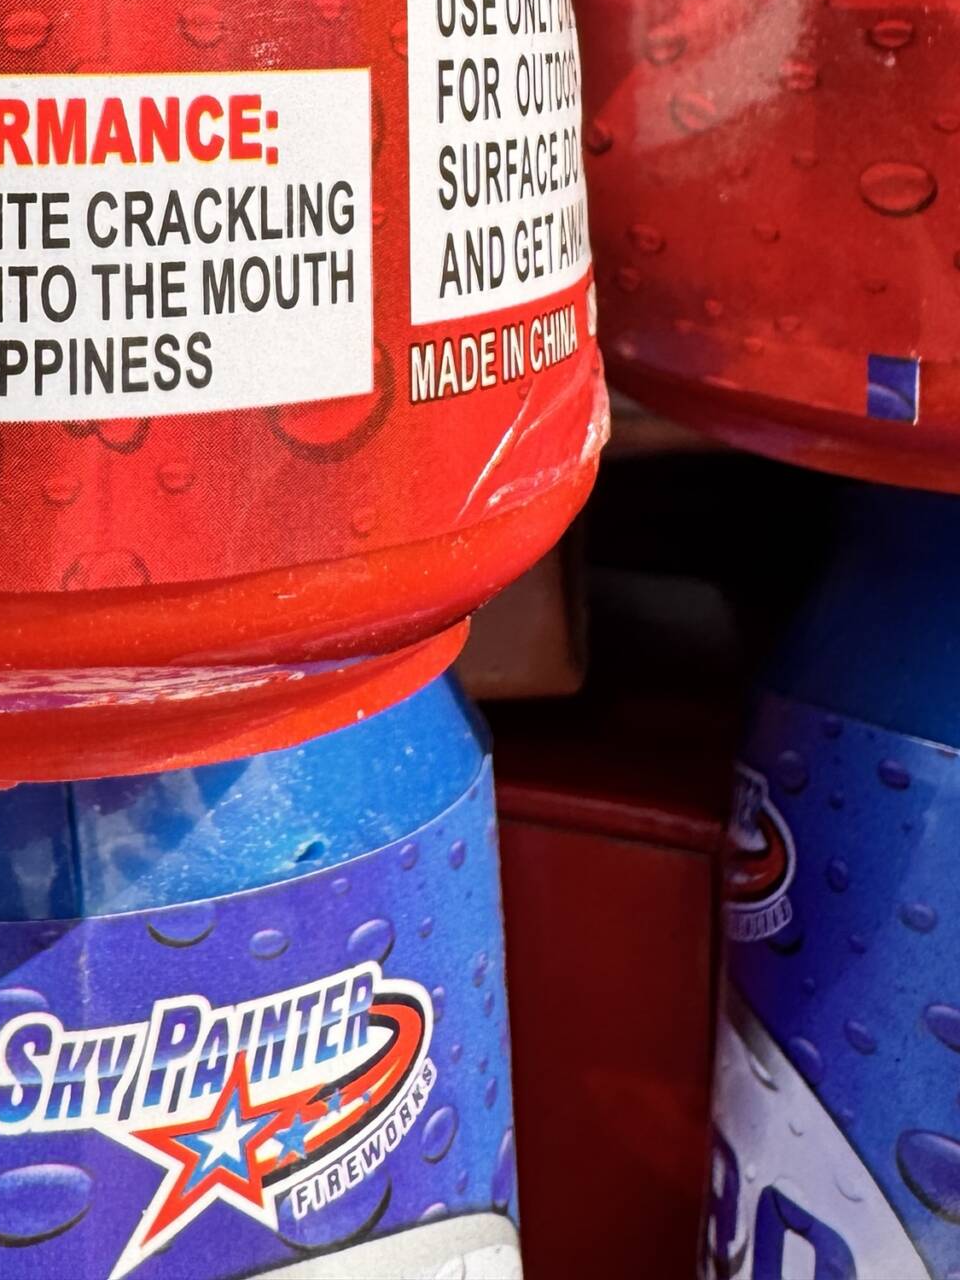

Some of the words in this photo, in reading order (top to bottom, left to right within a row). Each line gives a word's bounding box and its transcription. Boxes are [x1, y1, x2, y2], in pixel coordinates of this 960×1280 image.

[438, 57, 501, 124] FOR
[86, 180, 356, 249] CRACKLING
[439, 225, 505, 299] AND
[514, 213, 554, 283] GET
[92, 261, 188, 320] THE
[201, 249, 356, 315] MOUTH
[409, 329, 497, 403] MADE
[502, 323, 525, 382] IN
[529, 302, 578, 373] CHINA
[143, 970, 375, 1112] PAINTER
[294, 1062, 435, 1216] FIREWORKS
